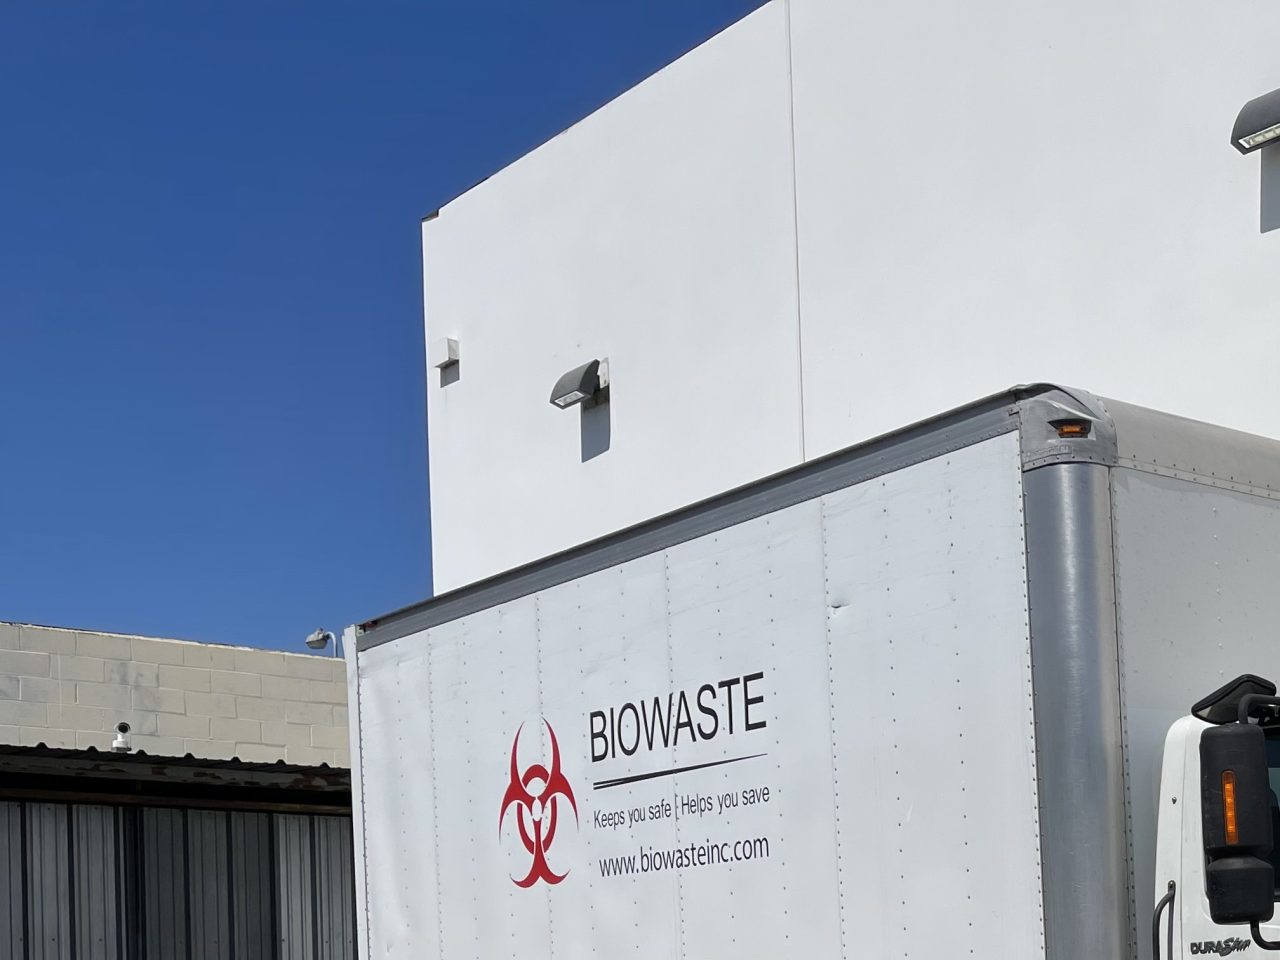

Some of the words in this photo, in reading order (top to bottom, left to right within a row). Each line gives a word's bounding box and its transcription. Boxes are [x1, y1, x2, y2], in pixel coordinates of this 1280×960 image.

[590, 671, 767, 762] BIOWASTE
[593, 809, 626, 830] Keeps
[628, 806, 646, 828] you
[648, 799, 672, 820] safe
[681, 794, 713, 818] Helps
[717, 791, 739, 815] you
[742, 786, 770, 806] save
[599, 836, 770, 877] www.biowasteinc.com
